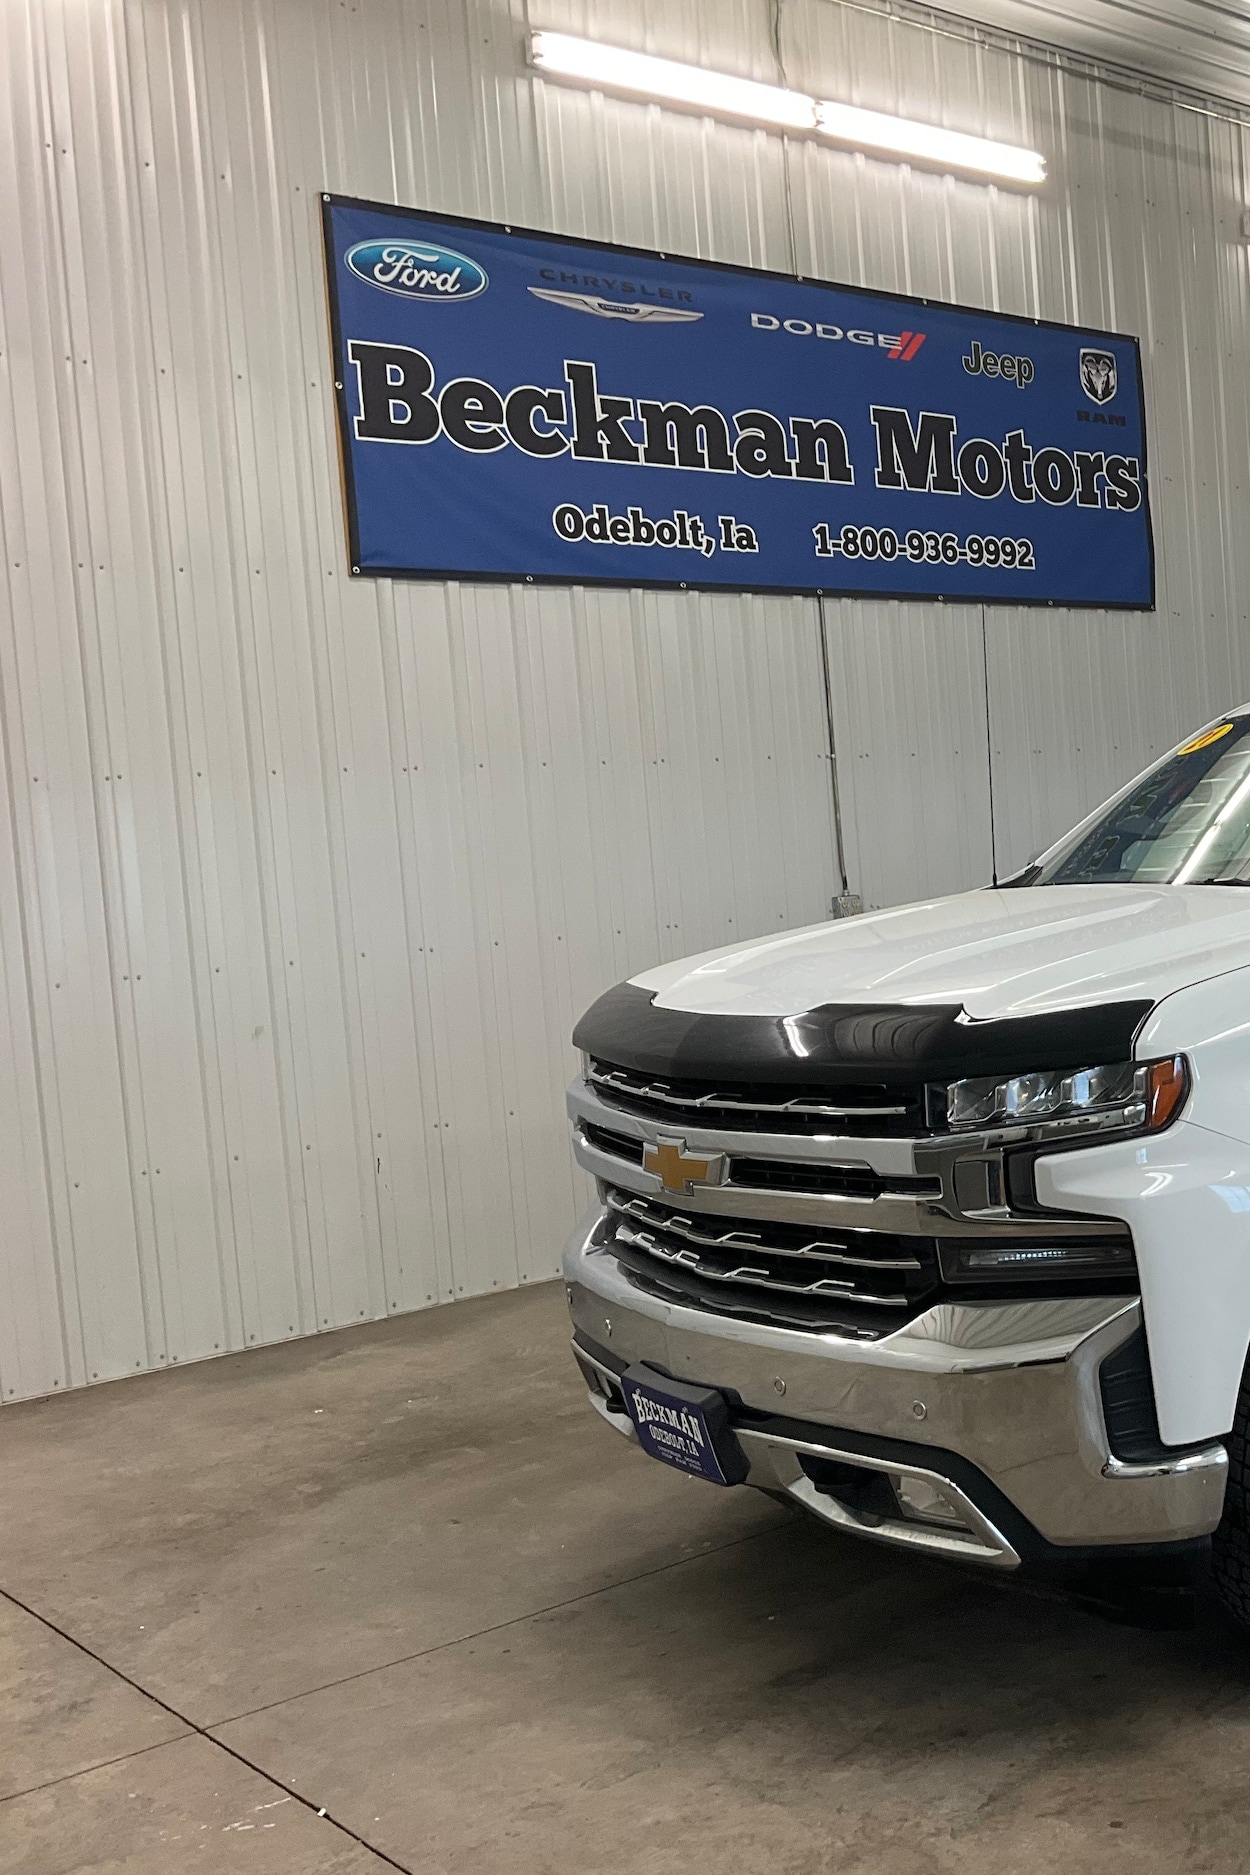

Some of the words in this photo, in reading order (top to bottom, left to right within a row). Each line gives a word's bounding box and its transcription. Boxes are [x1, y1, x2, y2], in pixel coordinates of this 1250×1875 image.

[373, 246, 461, 294] Ford
[539, 268, 693, 302] CHRYSLER
[751, 313, 904, 351] DODGE
[962, 341, 1035, 389] Jeep
[347, 339, 855, 486] Beckman
[870, 404, 1141, 512] Motors
[1076, 409, 1127, 427] RAM
[552, 502, 714, 558] Odebolt,
[719, 516, 759, 552] Ia
[812, 522, 1036, 570] 1-800-936-9992
[632, 1393, 704, 1447] BECKMAN
